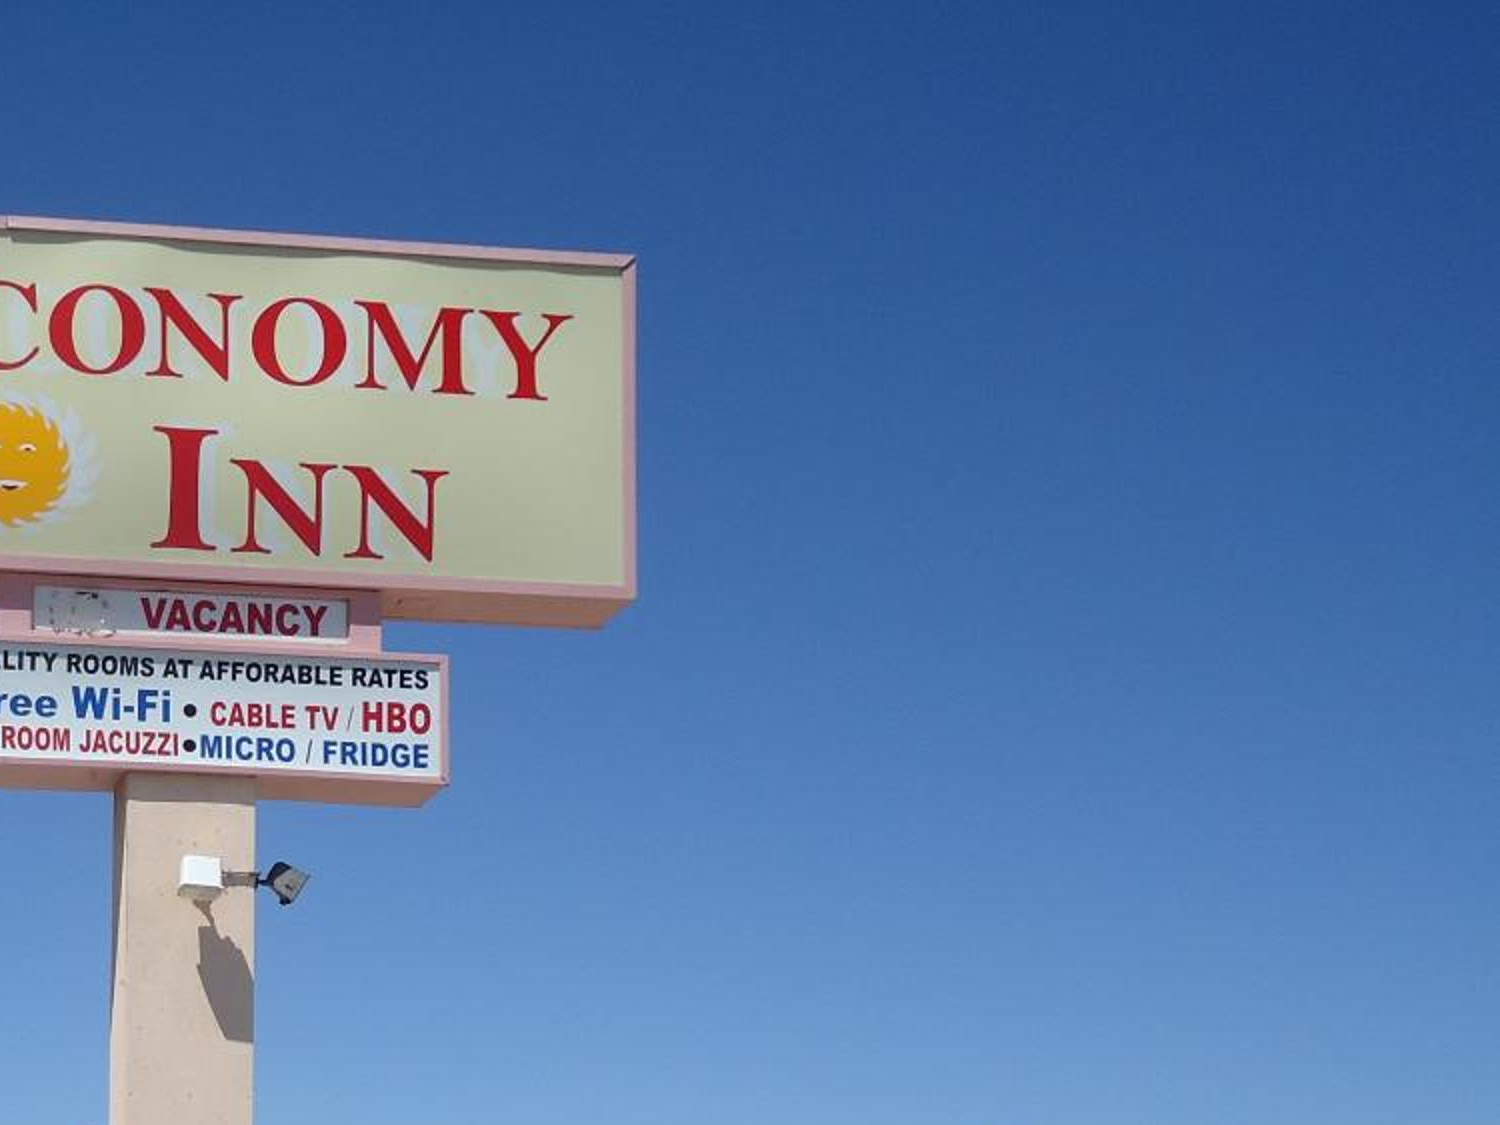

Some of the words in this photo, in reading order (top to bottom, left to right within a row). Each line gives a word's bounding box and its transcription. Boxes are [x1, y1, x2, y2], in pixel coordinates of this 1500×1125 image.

[151, 425, 449, 563] INN
[141, 596, 328, 636] VACANCY
[67, 653, 155, 677] ROOMS
[163, 657, 193, 679] AT
[199, 660, 343, 686] AFFORABLE
[352, 669, 429, 690] RATES
[72, 686, 171, 722] Wi-Fi
[210, 701, 296, 728] CABLE
[305, 706, 339, 730] TV
[362, 701, 431, 734] HBO
[1, 726, 71, 751] ROOM
[79, 729, 179, 756] JACUZZI
[200, 735, 296, 762] MICRO
[323, 741, 429, 769] FRIDGE
